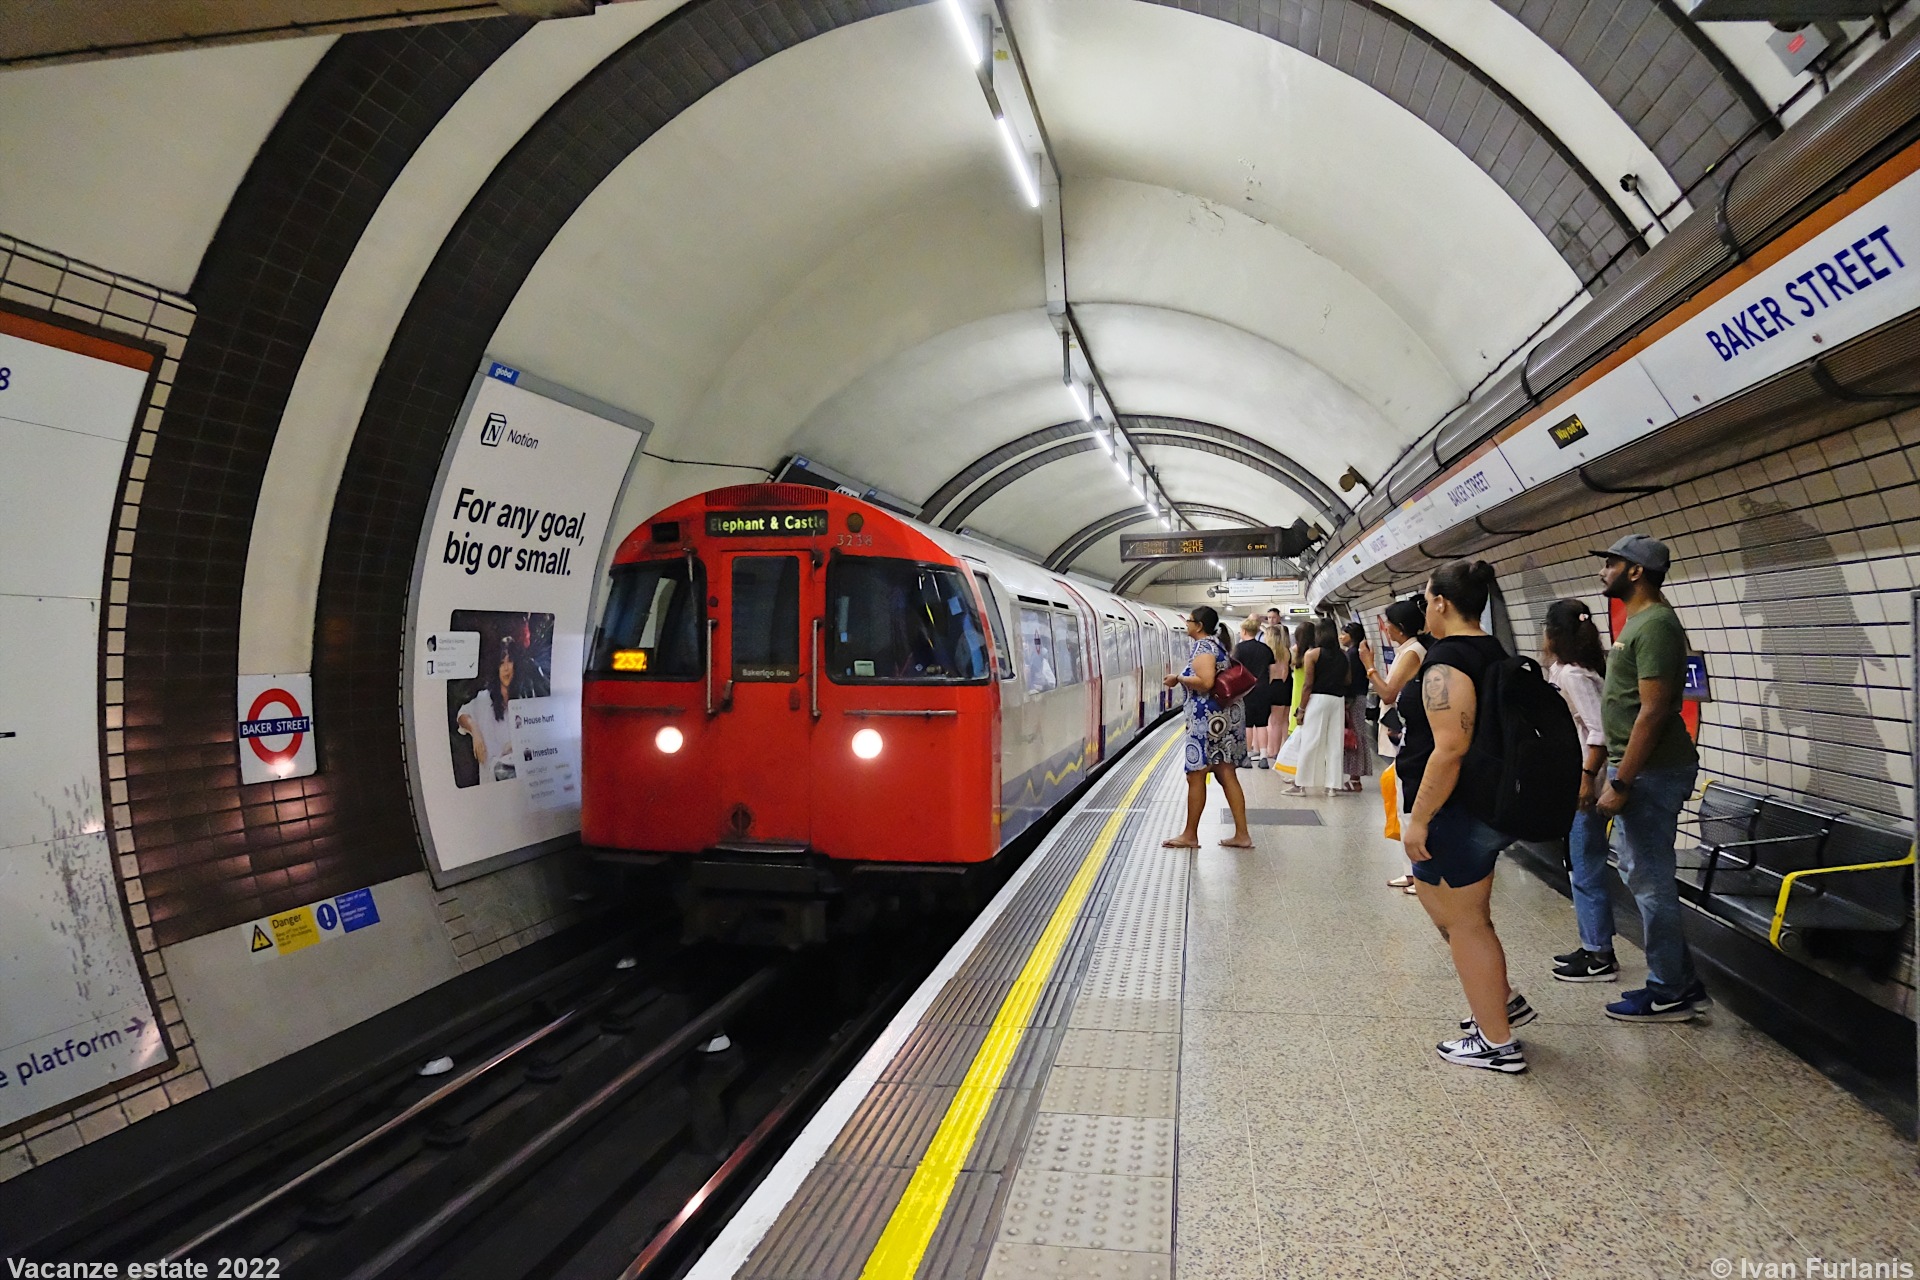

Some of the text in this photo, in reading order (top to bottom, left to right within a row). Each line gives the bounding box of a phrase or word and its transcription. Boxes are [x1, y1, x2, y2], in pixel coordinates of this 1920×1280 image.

[1705, 224, 1905, 362] BAKER STREET
[0, 366, 11, 391] 8
[494, 366, 514, 379] global
[507, 429, 539, 449] Notion
[1554, 422, 1579, 441] Way out
[1447, 470, 1491, 508] BAKER STREET
[453, 487, 587, 547] For any goal,
[710, 515, 825, 534] Elephant & Castle
[836, 534, 873, 546] 3238
[1247, 543, 1253, 551] 6
[443, 530, 571, 576] big or small.
[742, 668, 791, 678] Bakerloo line
[242, 719, 308, 736] BAKER STREET
[523, 714, 555, 725] House hunt
[532, 747, 559, 758] Investors
[271, 913, 302, 929] Danger
[16, 1029, 122, 1087] platform
